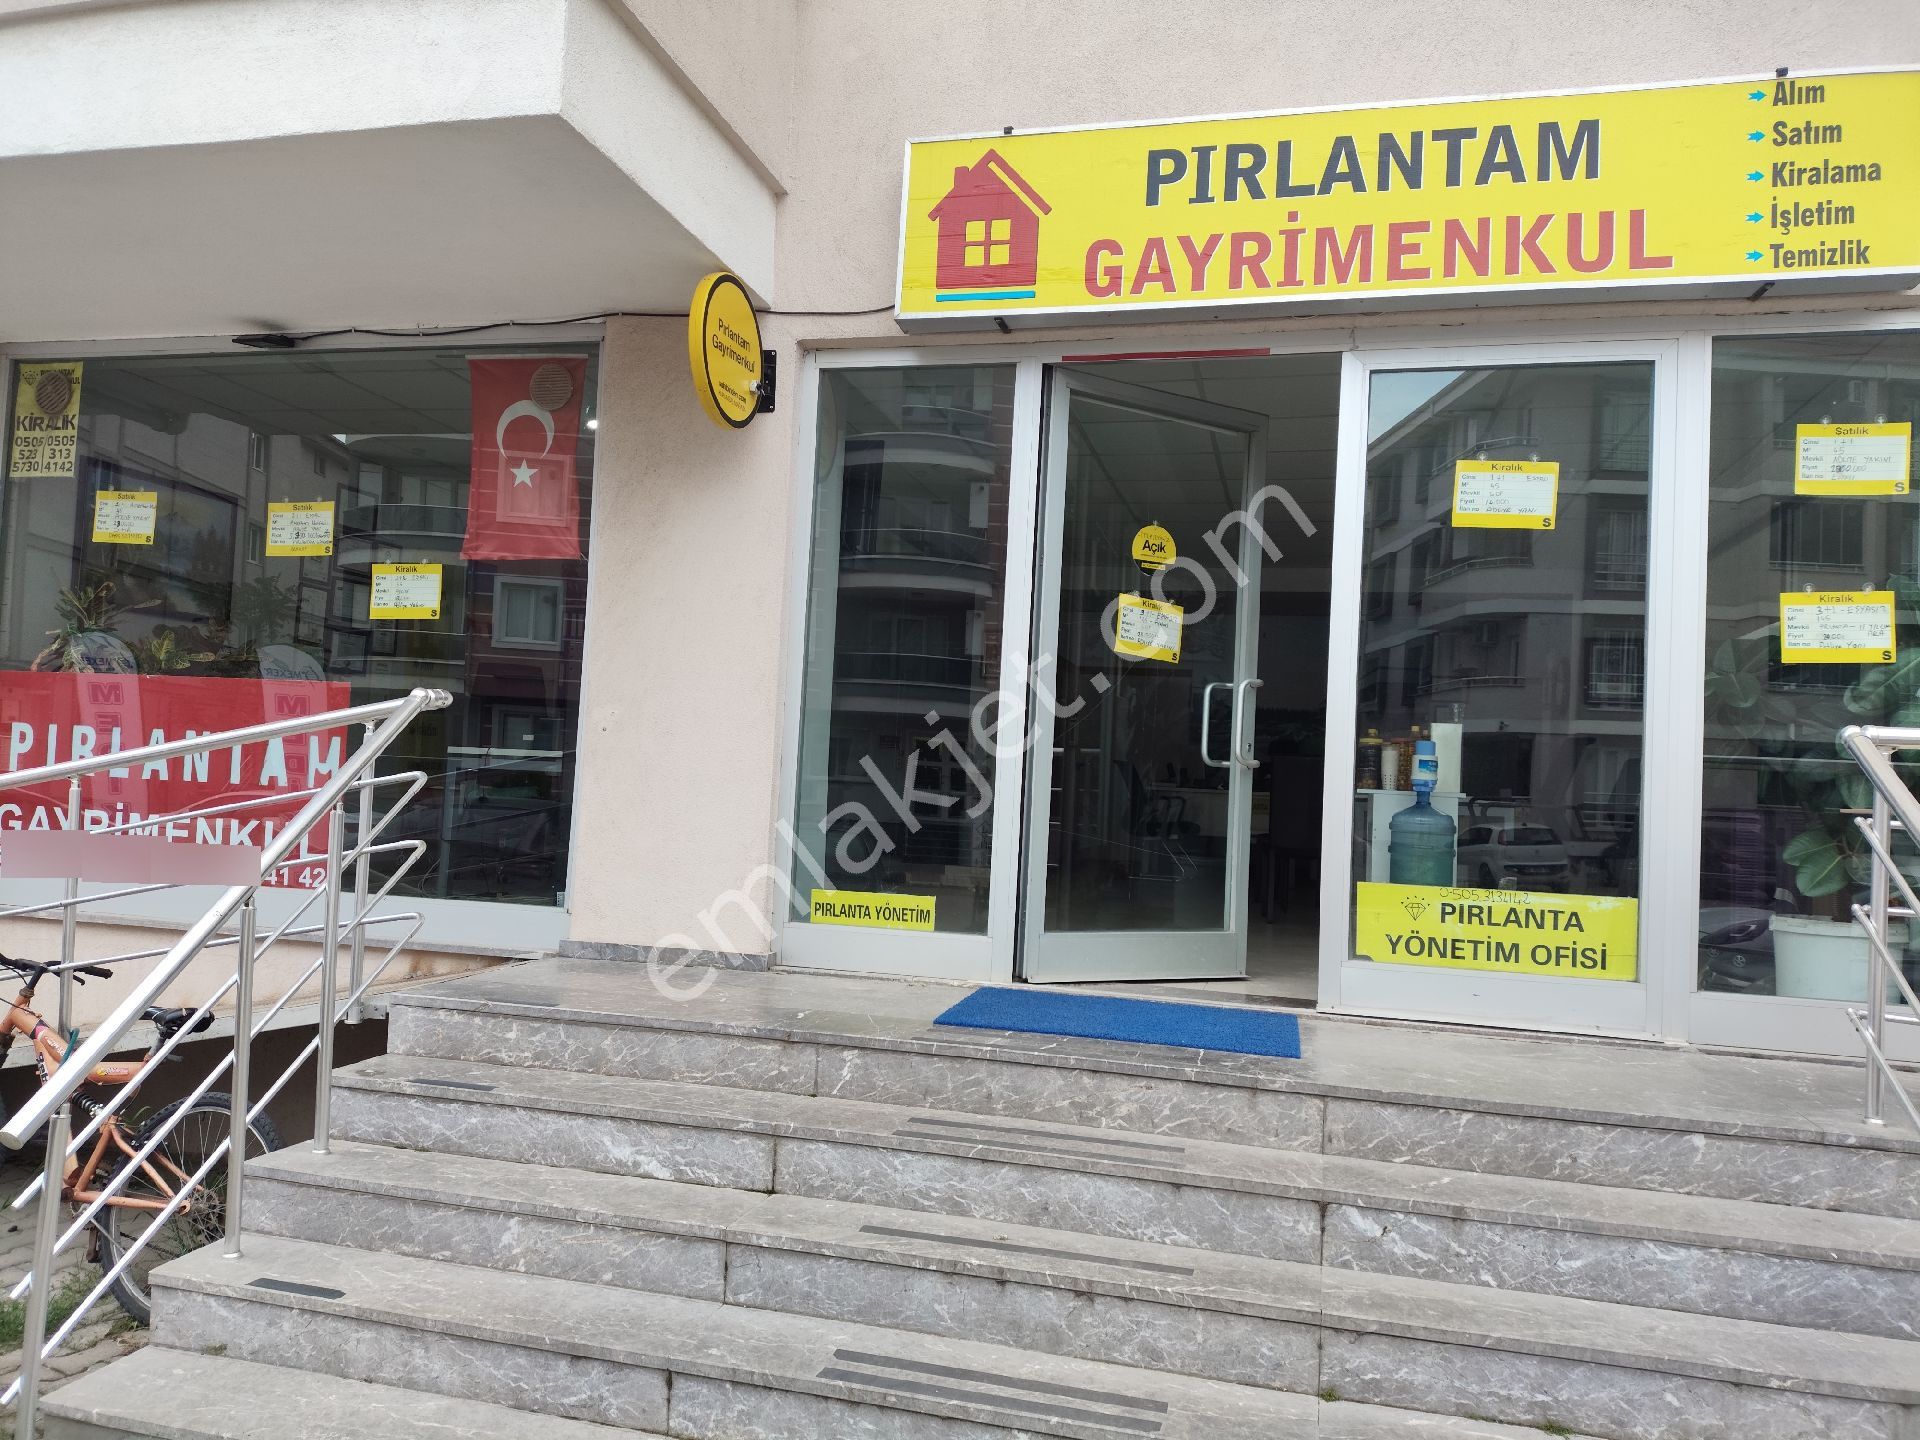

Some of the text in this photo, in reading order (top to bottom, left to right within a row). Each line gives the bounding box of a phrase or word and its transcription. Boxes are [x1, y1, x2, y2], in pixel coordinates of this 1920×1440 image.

[1772, 80, 1825, 107] Alım
[1772, 120, 1842, 146] Satım
[1145, 118, 1602, 207] PIRLANTAM
[1771, 159, 1882, 187] Kiralama
[1770, 196, 1855, 235] İşletim
[1084, 209, 1675, 298] GAYRİMENKUL
[1769, 239, 1871, 268] Temizlik
[712, 334, 756, 374] Gayrimenkul
[15, 435, 75, 447] 0505 0505
[1835, 426, 1869, 435] Satılık
[18, 448, 71, 460] 523 313
[11, 461, 73, 473] 5730 4142
[1491, 464, 1523, 472] Kiralık
[324, 546, 331, 554] S
[1142, 539, 1166, 555] Açık
[395, 565, 418, 573] Kiralık
[1820, 594, 1854, 603] Kiralık
[1171, 652, 1178, 661] S
[1882, 650, 1892, 660] S
[299, 866, 326, 888] 42
[814, 902, 931, 924] PIRLANTA YÖNETİM
[1440, 902, 1585, 932] PIRLANTA
[1385, 930, 1607, 971] YÖNETİM OFİSİ
